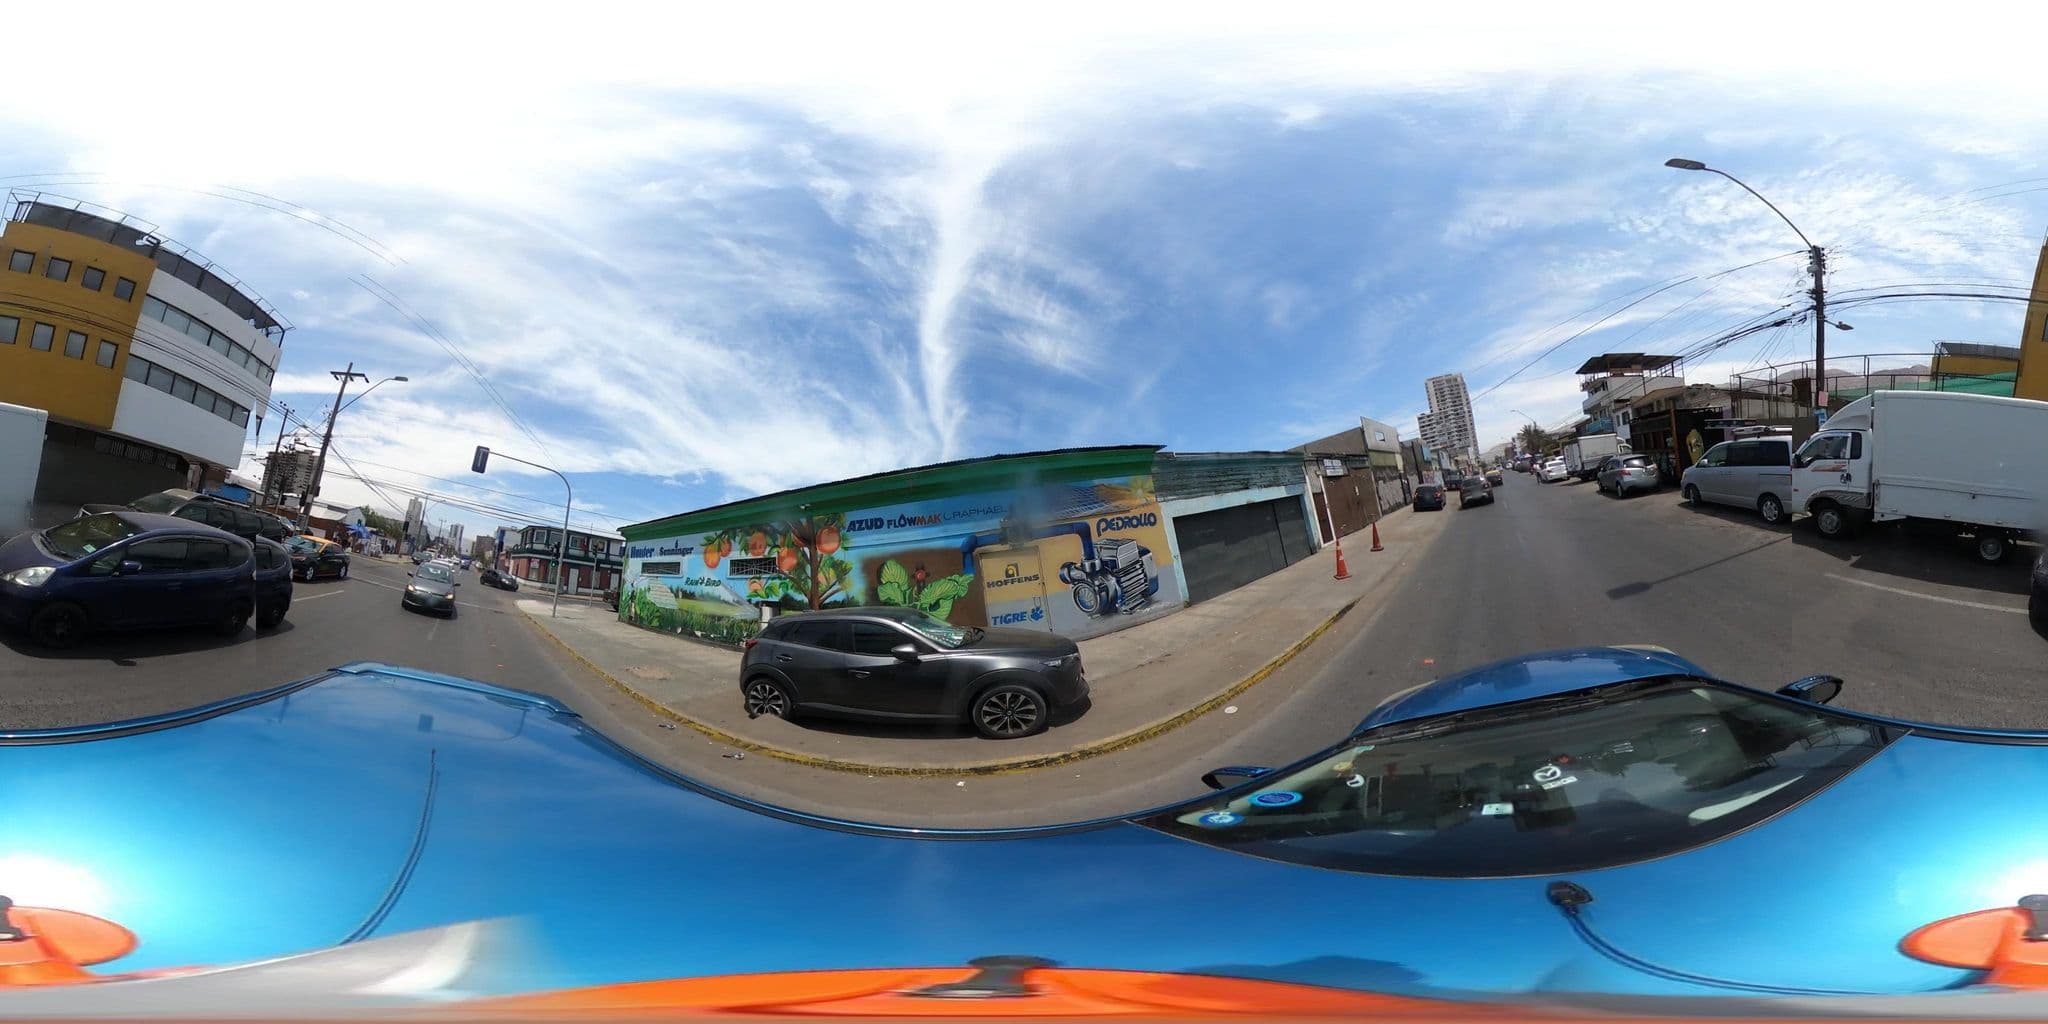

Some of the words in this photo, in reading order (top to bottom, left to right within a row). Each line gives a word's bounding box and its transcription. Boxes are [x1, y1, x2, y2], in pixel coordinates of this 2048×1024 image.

[846, 516, 885, 532] AZUD
[987, 574, 1040, 588] HOFFENS
[991, 611, 1028, 625] TIGRE
